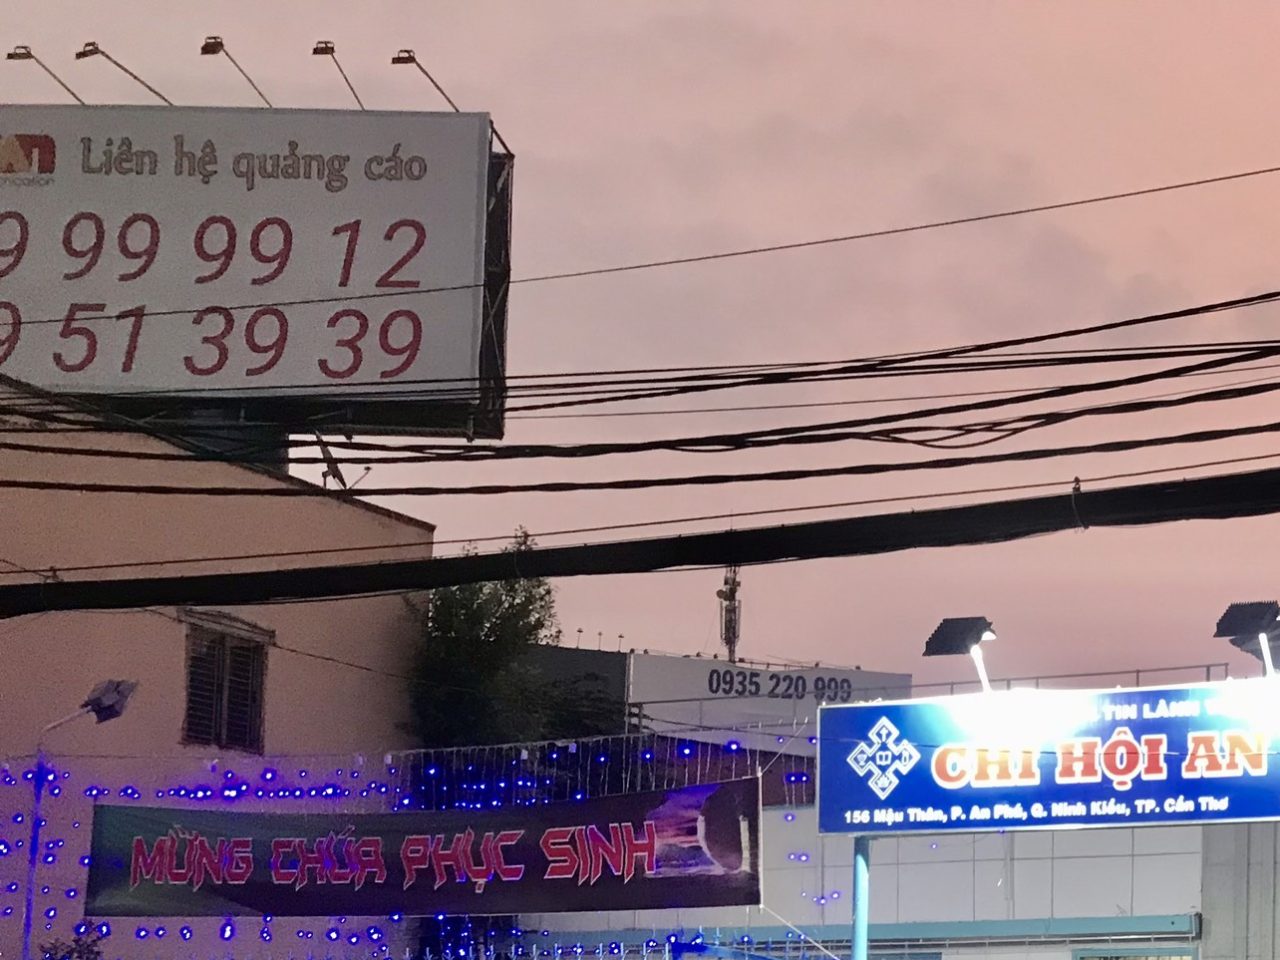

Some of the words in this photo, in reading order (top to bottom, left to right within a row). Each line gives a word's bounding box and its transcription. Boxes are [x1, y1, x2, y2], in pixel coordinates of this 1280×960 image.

[81, 136, 159, 176] Liên
[173, 134, 219, 185] hệ
[232, 140, 351, 193] quảng
[364, 143, 428, 182] cáo
[62, 211, 161, 282] 99
[193, 215, 294, 286] 99
[331, 218, 427, 288] 12
[52, 302, 147, 373] 51
[183, 305, 290, 377] 39
[317, 308, 423, 379] 39
[708, 669, 761, 696] 0935
[767, 673, 807, 700] 220
[814, 676, 852, 702] 999
[932, 742, 1041, 789] CHI
[1056, 727, 1167, 791] HỘI
[1182, 731, 1268, 779] AN
[845, 810, 870, 823] 156
[951, 806, 967, 821] P.
[970, 805, 991, 820] An
[1134, 799, 1160, 814] TP.
[272, 825, 387, 892] CHÚA
[401, 826, 525, 894] PHỤC
[540, 820, 656, 886] SINH
